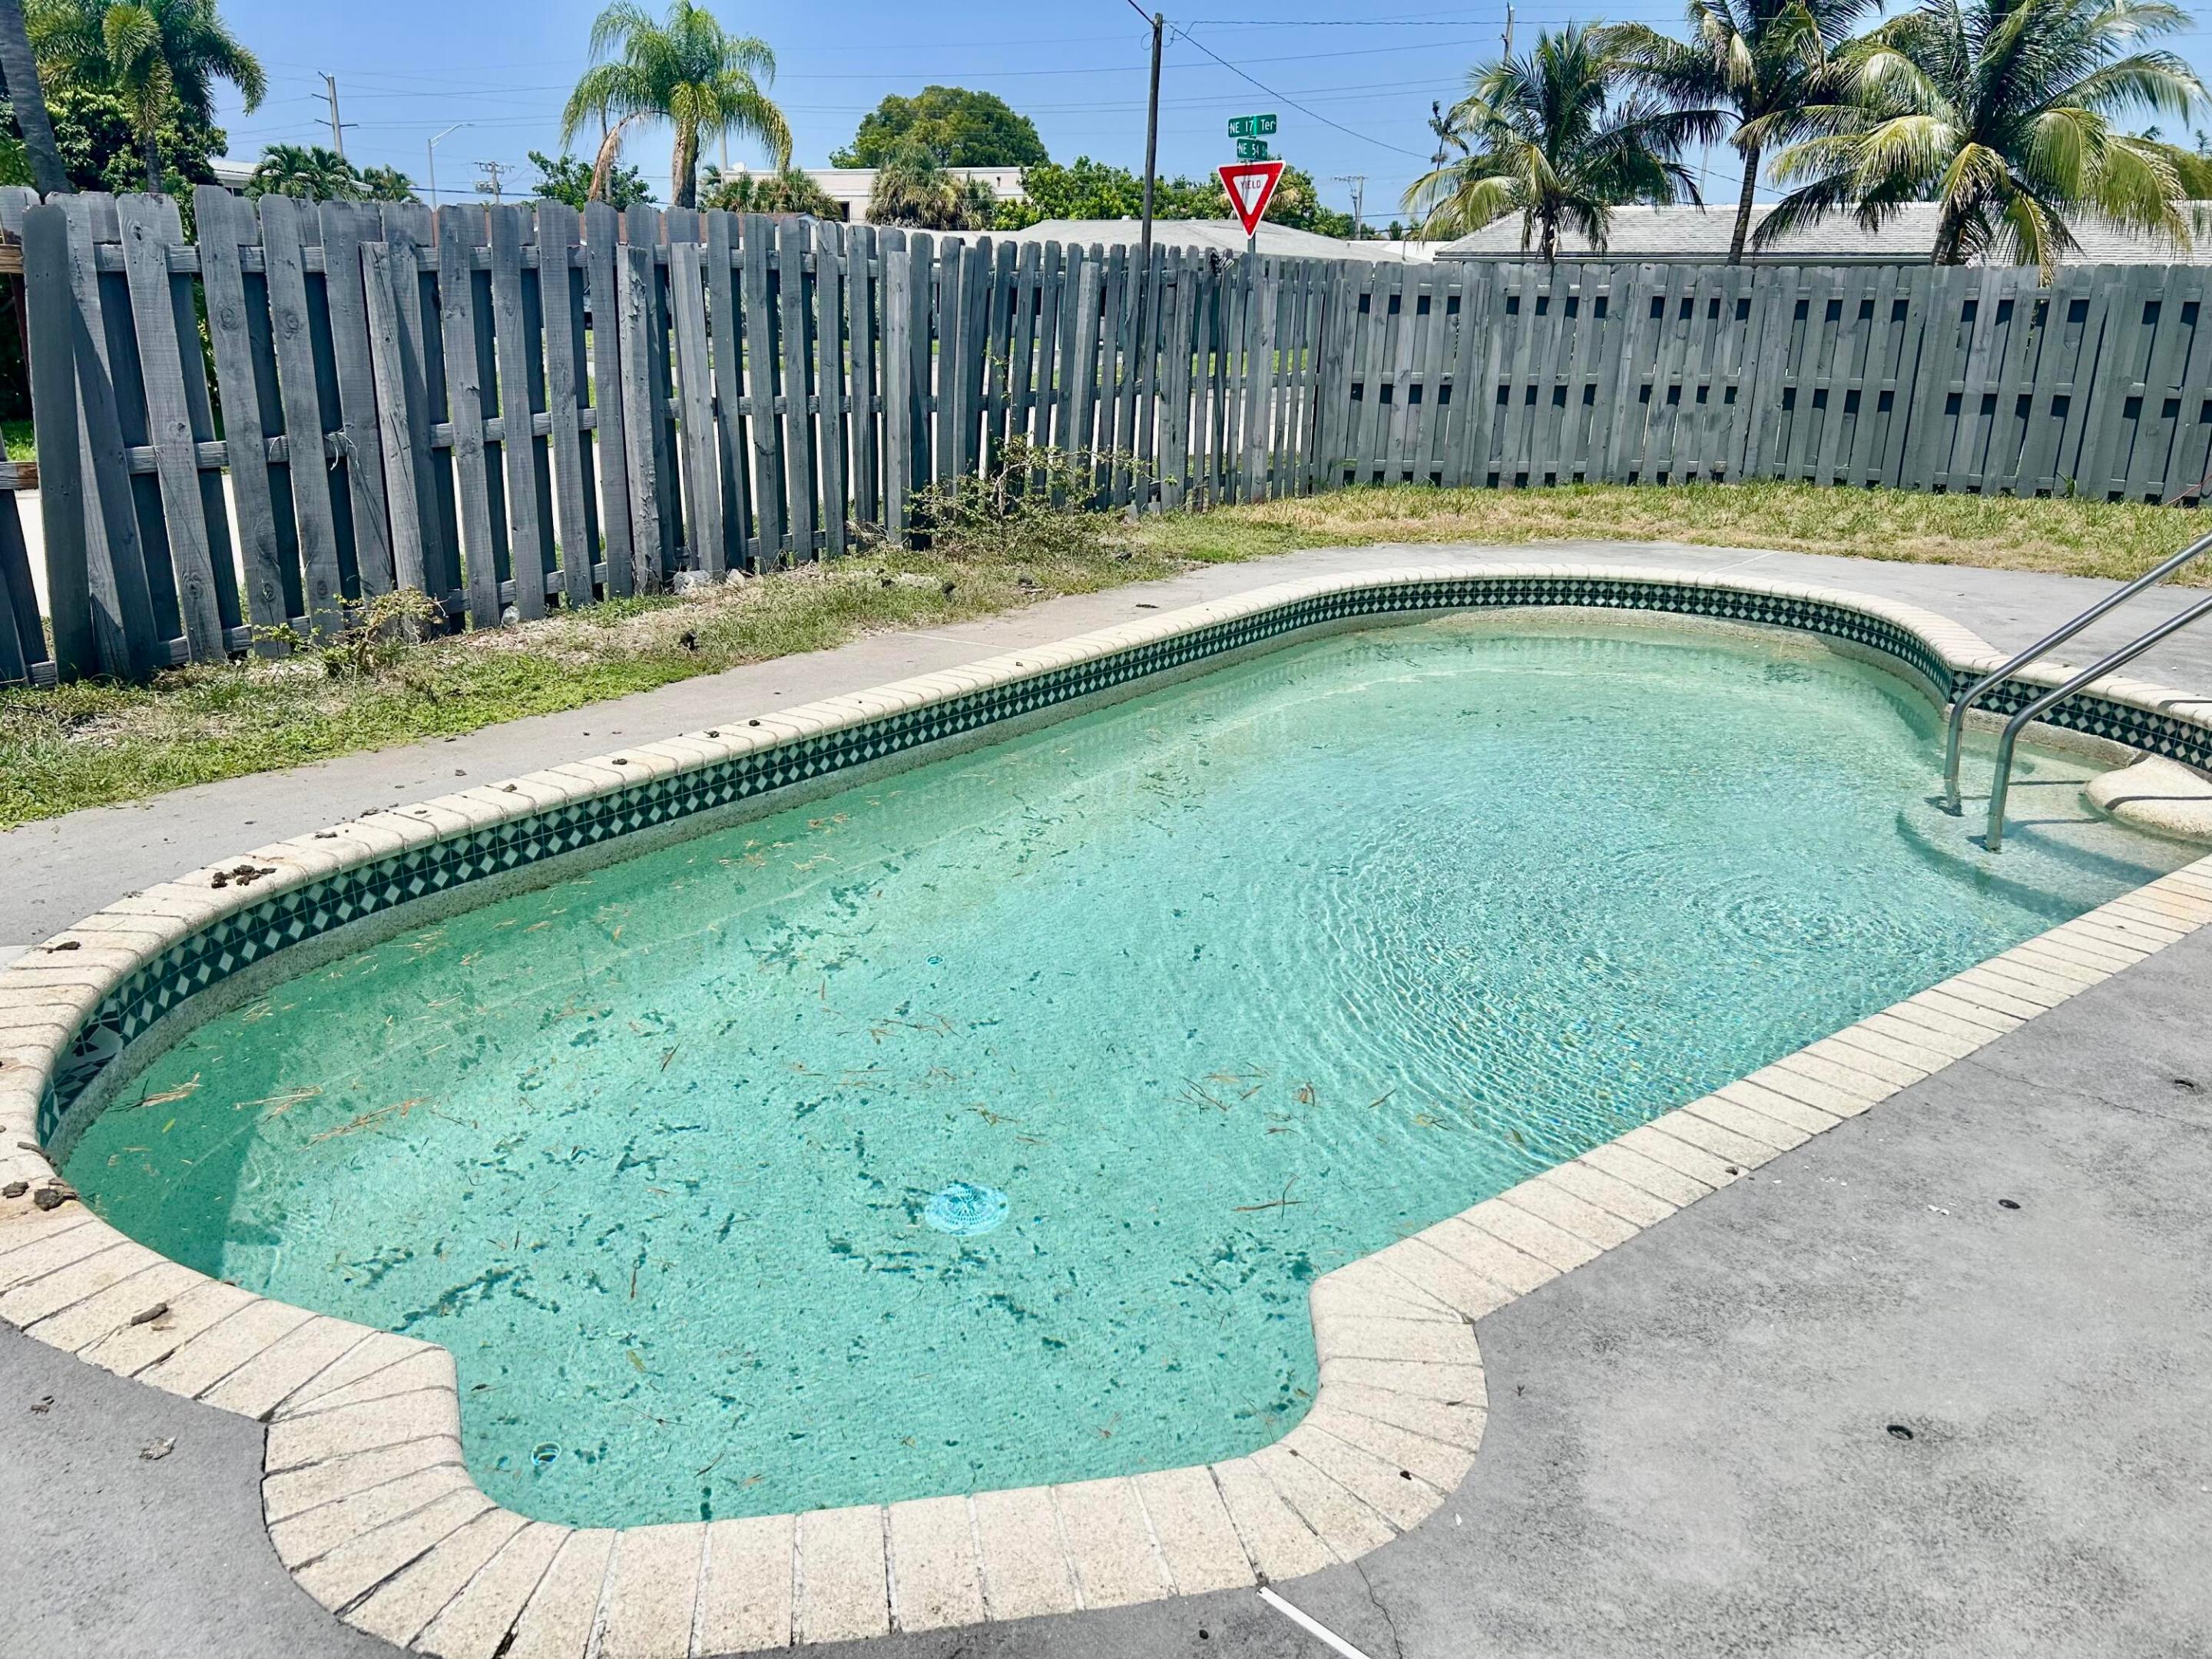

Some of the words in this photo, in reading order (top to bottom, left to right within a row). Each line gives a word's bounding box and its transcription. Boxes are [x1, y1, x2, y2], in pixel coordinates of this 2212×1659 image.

[1230, 121, 1240, 134] NE
[1245, 120, 1253, 132] 17
[1260, 118, 1274, 131] Ter
[1238, 142, 1247, 154] NE
[1240, 180, 1260, 189] YIELD
